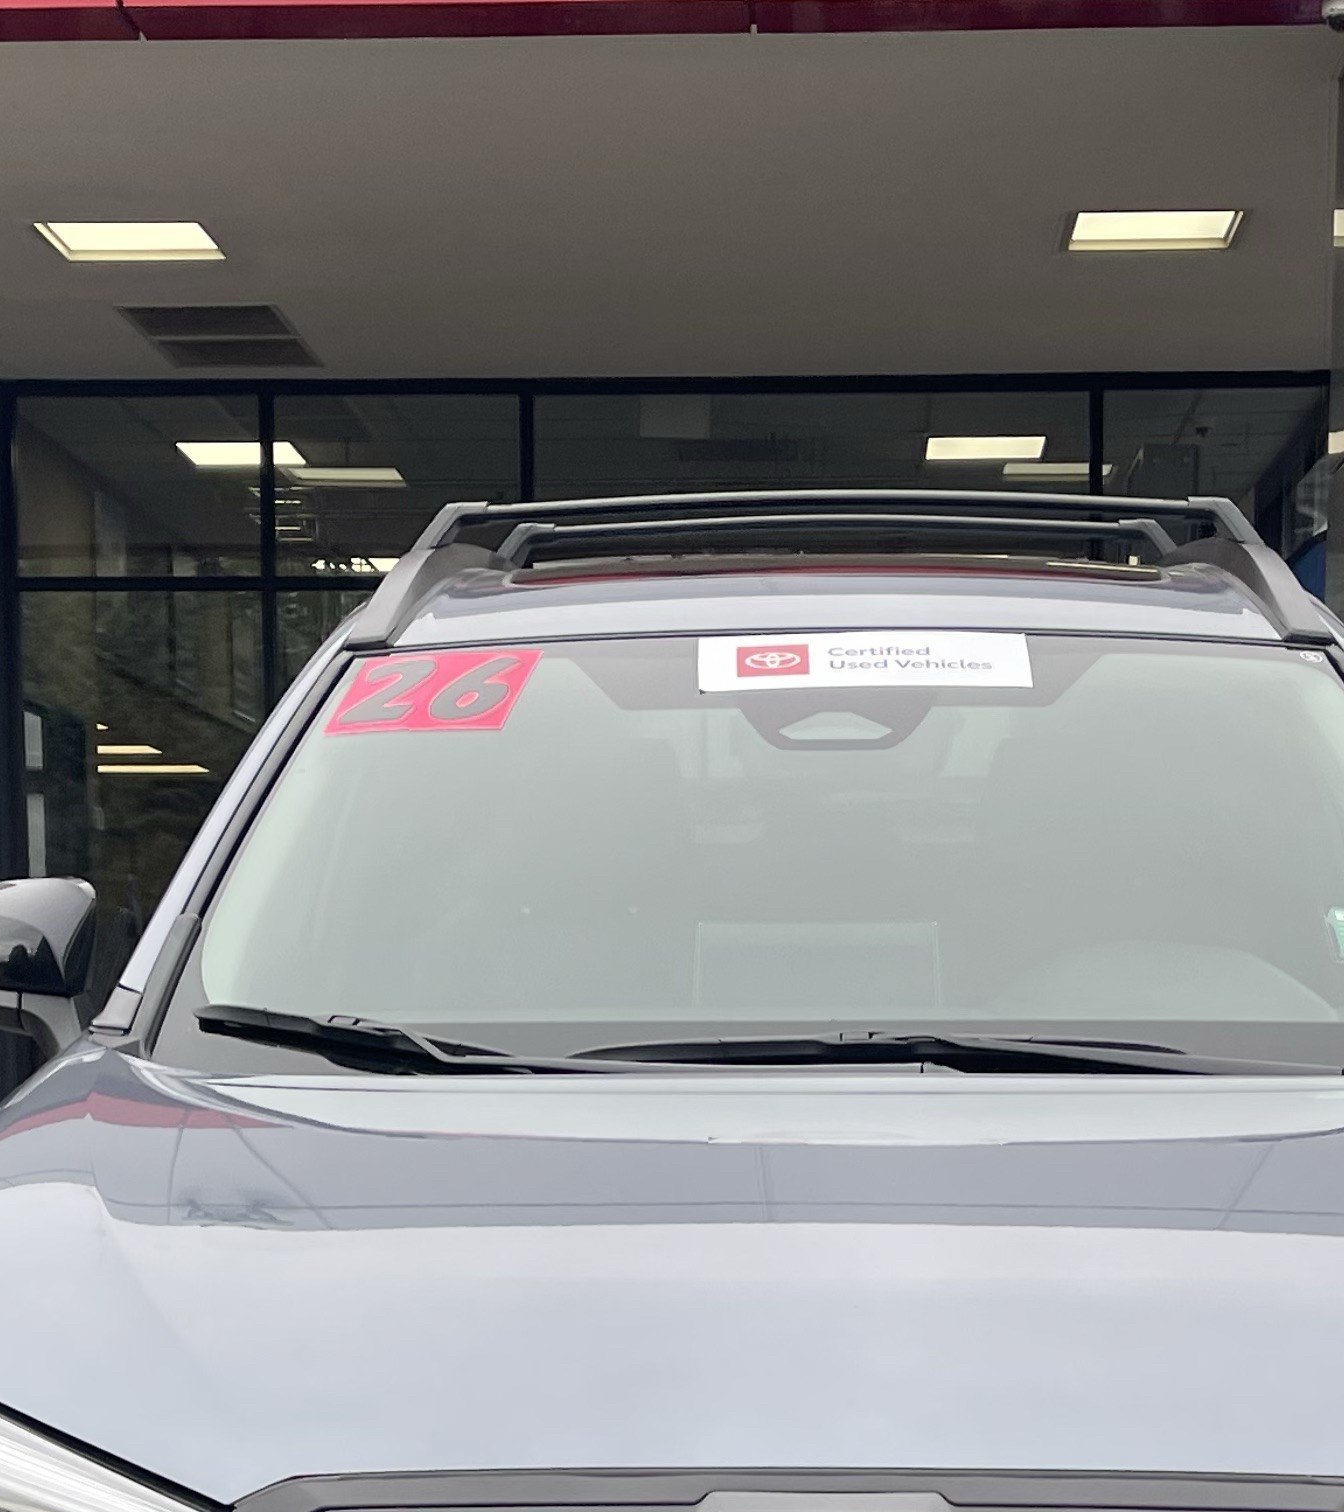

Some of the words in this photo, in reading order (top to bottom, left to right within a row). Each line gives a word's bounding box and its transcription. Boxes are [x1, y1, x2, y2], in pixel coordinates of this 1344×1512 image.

[827, 646, 931, 657] Certified
[829, 659, 889, 670] Used
[895, 659, 993, 670] Vehicles
[337, 655, 523, 725] 26
